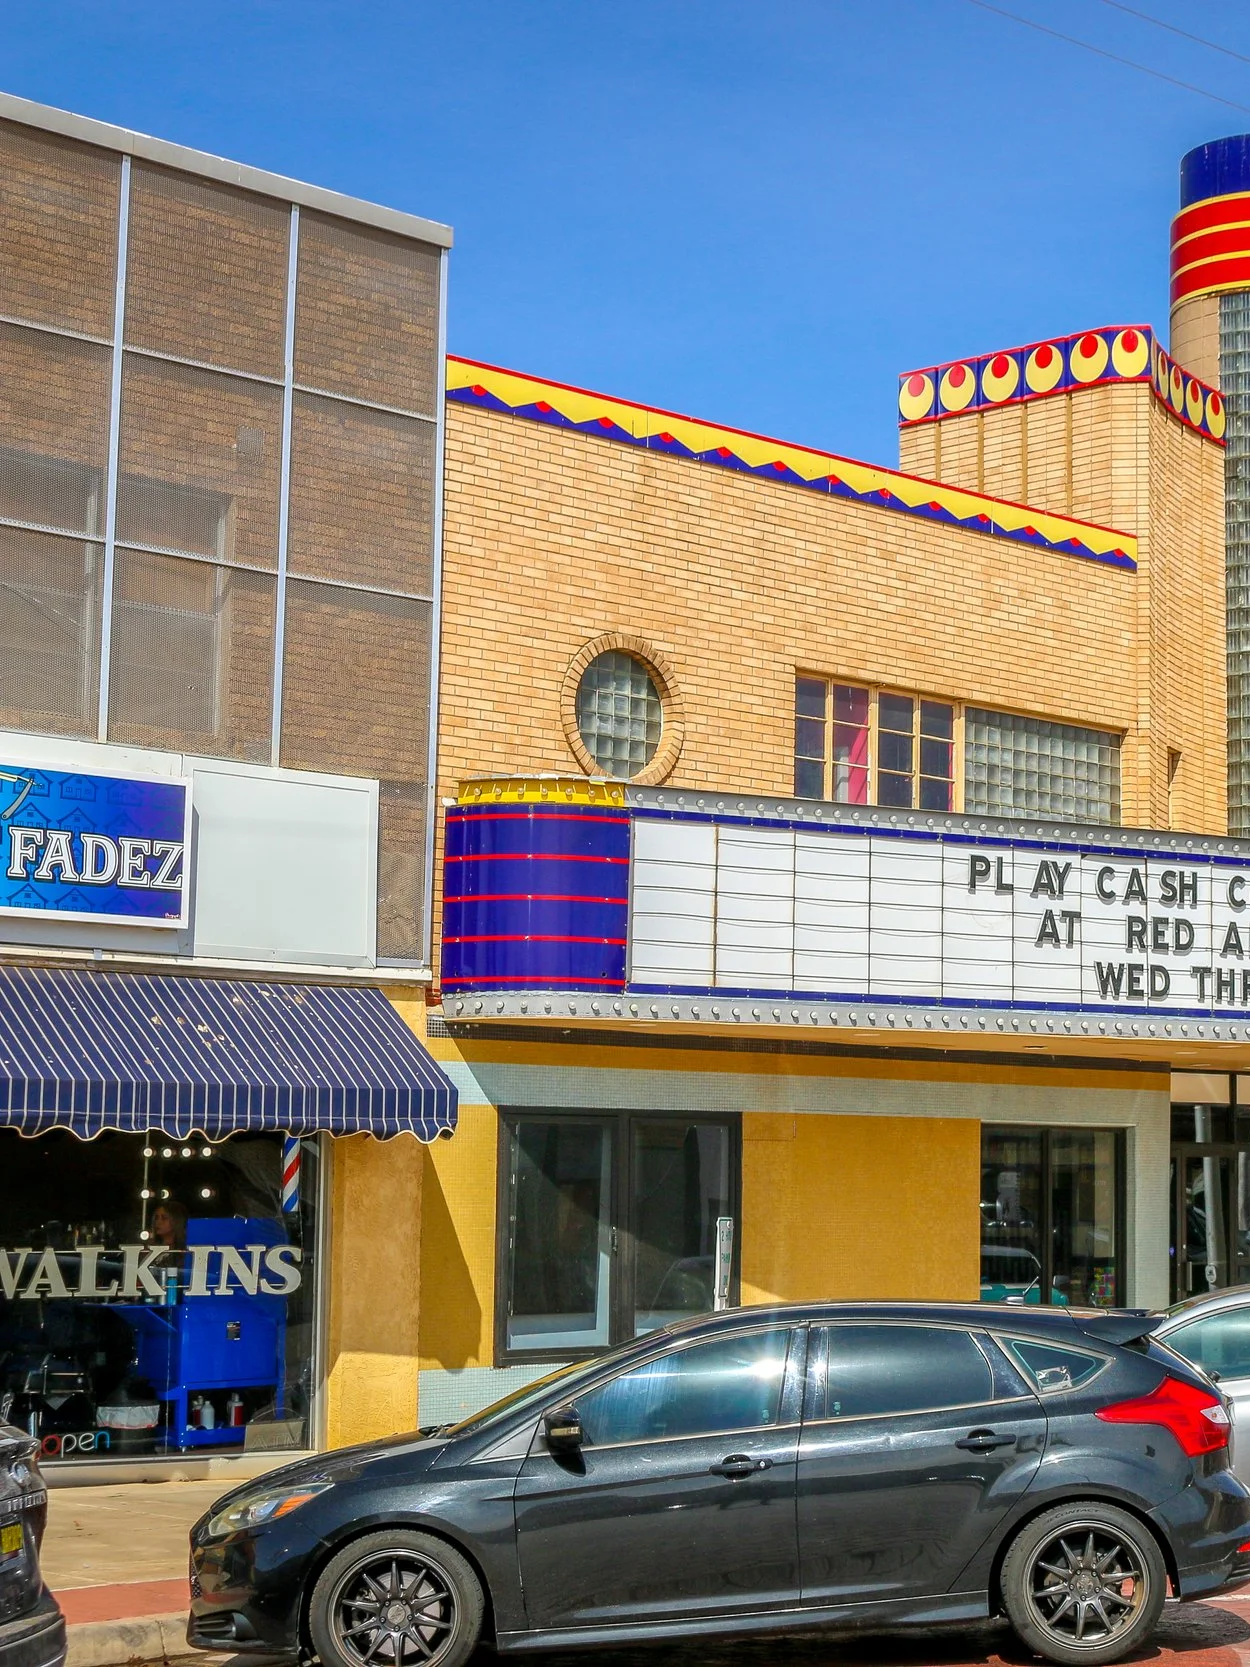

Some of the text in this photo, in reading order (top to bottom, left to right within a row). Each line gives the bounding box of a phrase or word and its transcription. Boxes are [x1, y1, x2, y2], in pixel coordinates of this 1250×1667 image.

[7, 826, 185, 889] FADEZ
[968, 854, 1072, 900] PLAY
[1095, 865, 1199, 909] CASH
[1034, 909, 1081, 949] AT
[1125, 914, 1195, 956] RED
[1094, 961, 1171, 1001] WED
[184, 1245, 302, 1296] INS
[41, 1431, 111, 1458] open
